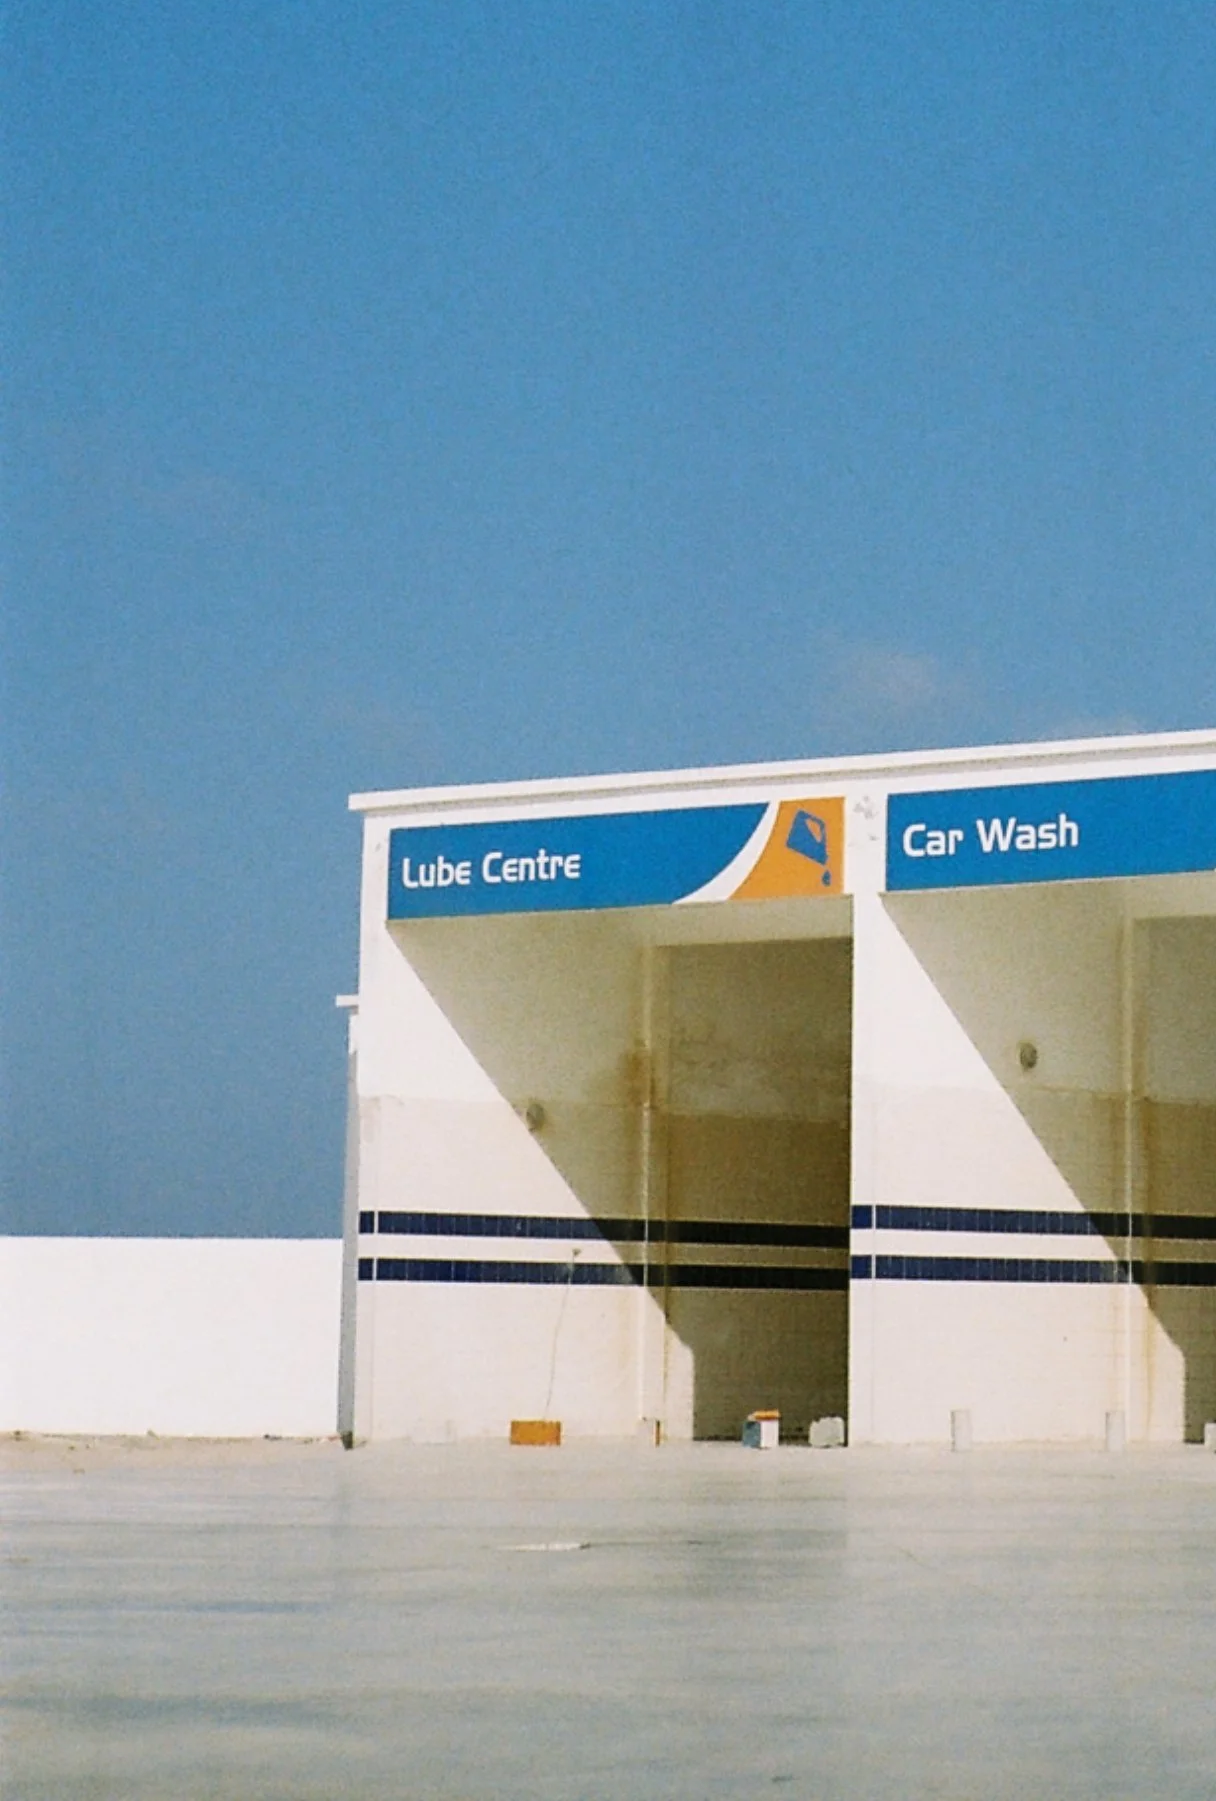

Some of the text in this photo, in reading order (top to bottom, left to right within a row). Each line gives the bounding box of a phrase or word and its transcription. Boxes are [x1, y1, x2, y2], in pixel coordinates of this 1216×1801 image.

[903, 813, 1078, 857] Car Wash
[402, 849, 581, 889] Lube Centre
